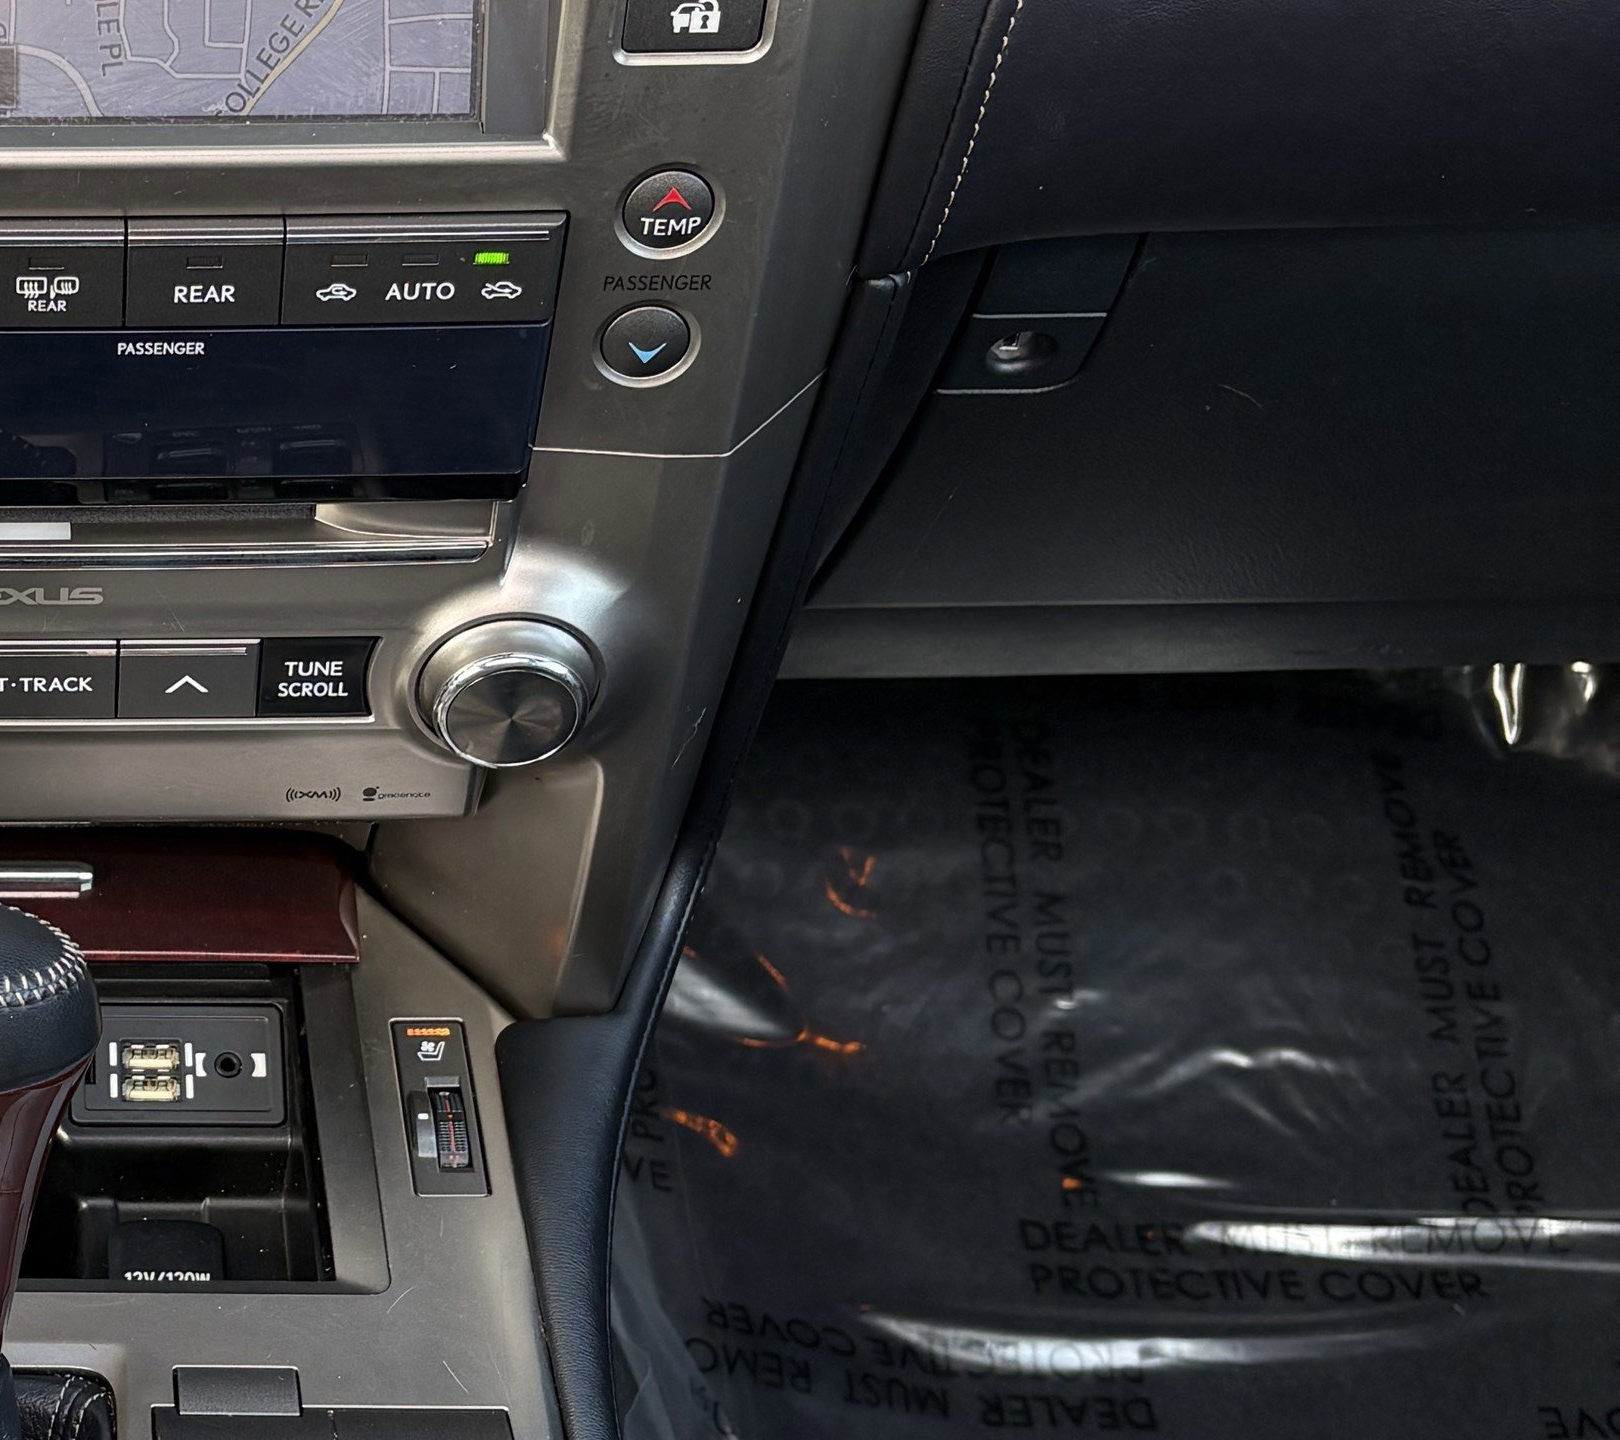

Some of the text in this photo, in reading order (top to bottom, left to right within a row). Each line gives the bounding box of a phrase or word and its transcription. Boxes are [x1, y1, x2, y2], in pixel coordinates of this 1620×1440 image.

[101, 40, 123, 77] PL
[215, 14, 305, 116] OLLEGE
[641, 216, 702, 237] TEMP
[385, 282, 455, 302] AUTO
[603, 274, 712, 292] PASSENGER
[173, 284, 236, 305] REAR
[27, 298, 67, 313] REAR
[117, 341, 205, 356] PASSENGER
[284, 661, 343, 678] TUNE
[278, 681, 349, 698] SCROLL
[1018, 1217, 1194, 1257] DEALER
[1028, 1264, 1491, 1304] PROTECTIVE COVER
